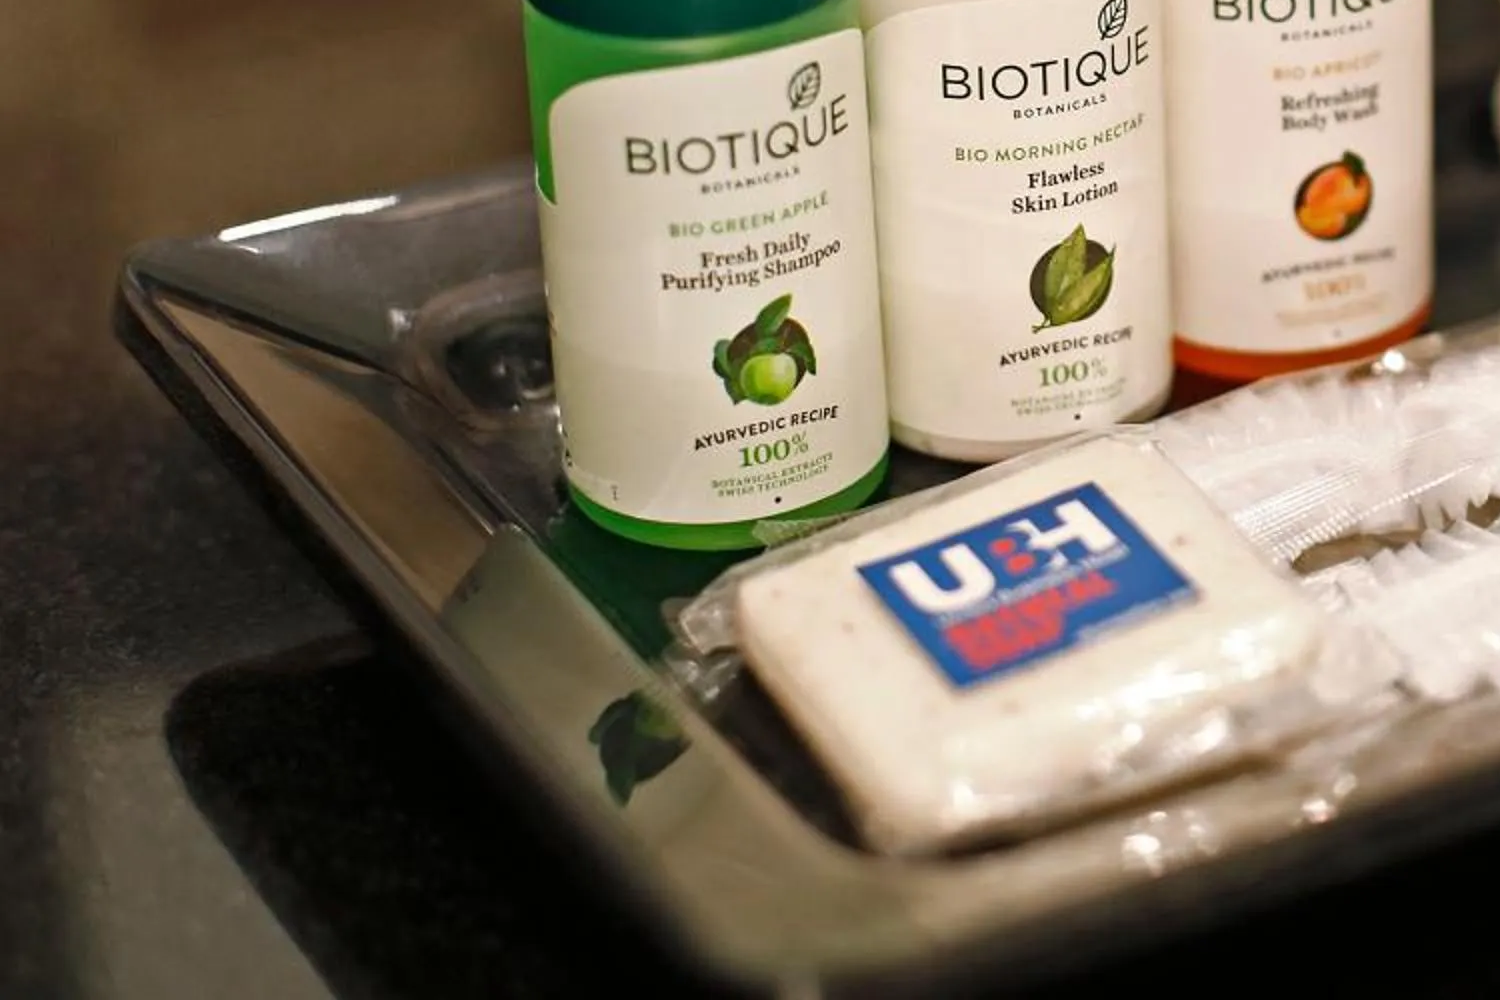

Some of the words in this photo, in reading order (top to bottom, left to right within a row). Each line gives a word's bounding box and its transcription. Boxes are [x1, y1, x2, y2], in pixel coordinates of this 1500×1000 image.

[941, 25, 1149, 101] BIOTIQUE
[1013, 93, 1108, 119] BOTANICALS
[1281, 83, 1380, 112] Refreshing
[1282, 112, 1327, 133] Body
[1335, 101, 1379, 124] Wash
[625, 93, 849, 176] BIOTIQUE
[955, 147, 988, 162] BIO
[995, 137, 1088, 162] MORNING
[701, 167, 801, 195] BOTANICALS
[1027, 160, 1105, 190] Flawless
[1011, 192, 1058, 215] Skin
[1063, 179, 1119, 208] Lotion
[668, 221, 705, 239] BIO
[710, 210, 776, 236] GREEN
[781, 190, 830, 220] APPLE
[661, 267, 761, 292] Purifying
[764, 239, 841, 279] Shampoo
[700, 243, 759, 270] Fresh
[763, 231, 812, 258] Daily
[1000, 336, 1088, 366] AYURVEDIC
[1040, 355, 1108, 387] 100%
[694, 417, 786, 451] AYURVEDIC
[790, 405, 839, 426] RECIPE
[740, 430, 809, 468] 100%
[711, 471, 778, 489] BOTANICAL
